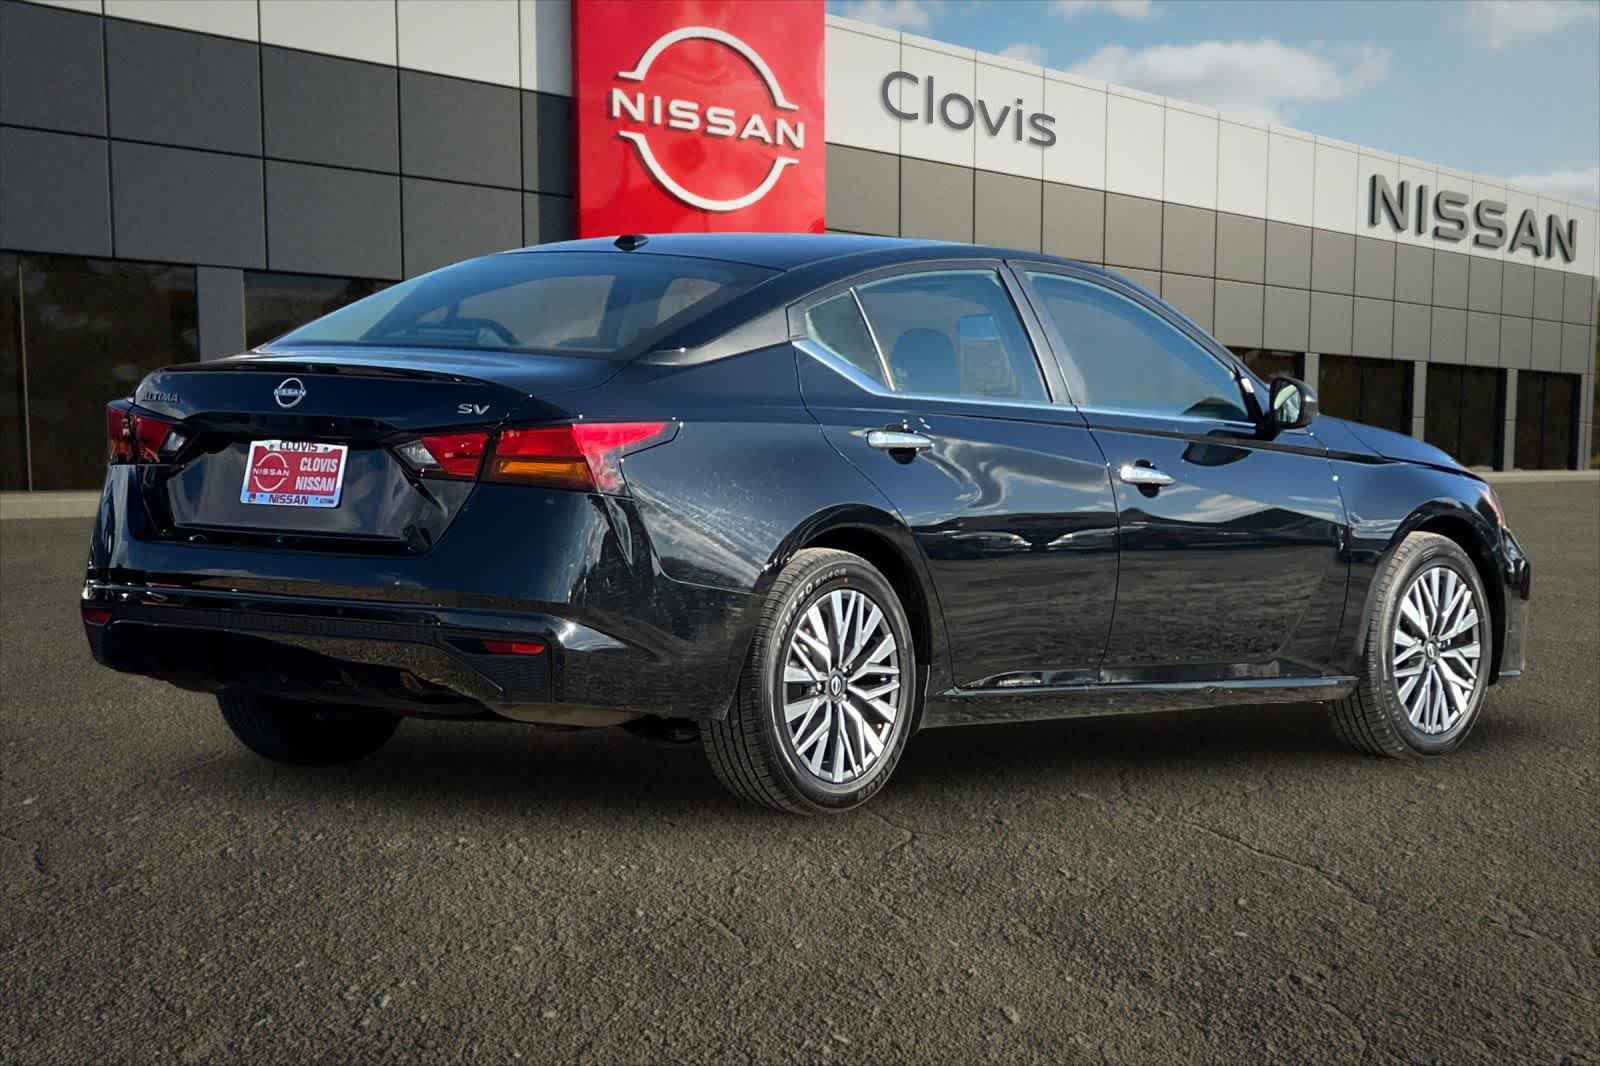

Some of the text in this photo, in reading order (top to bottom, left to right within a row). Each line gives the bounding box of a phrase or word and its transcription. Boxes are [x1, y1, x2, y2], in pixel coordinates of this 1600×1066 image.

[881, 71, 1057, 147] Clovis
[611, 87, 804, 149] NISSAN
[1368, 174, 1577, 264] NISSAN
[457, 403, 490, 415] SV
[280, 441, 318, 452] CLOVIS
[253, 468, 290, 477] NISSAN
[300, 457, 338, 473] CLOVIS
[295, 476, 335, 492] NISSAN
[268, 494, 309, 505] NISSAN
